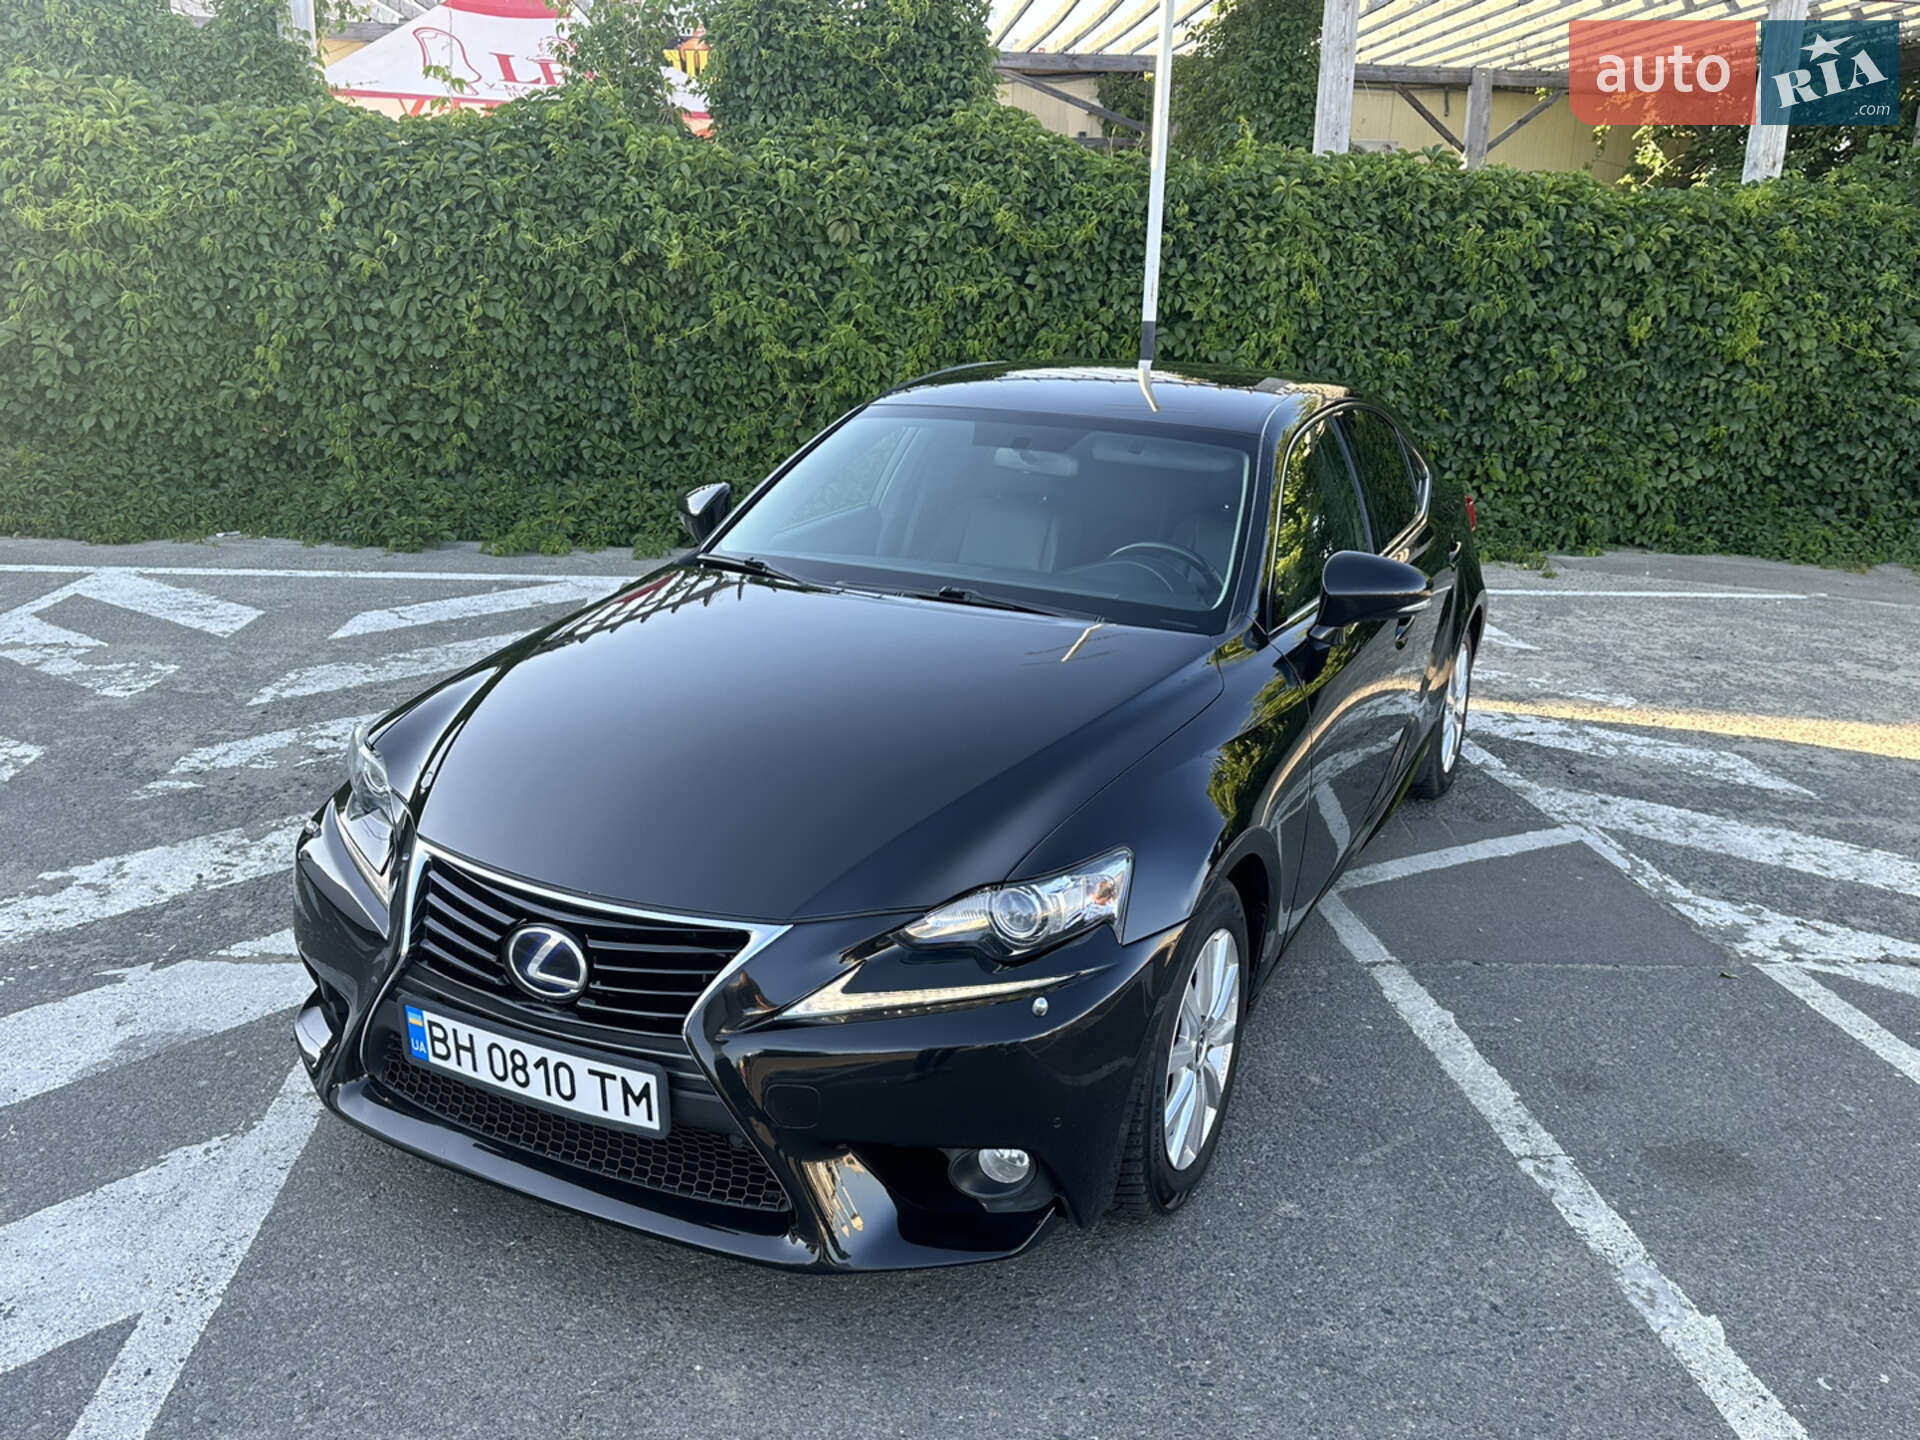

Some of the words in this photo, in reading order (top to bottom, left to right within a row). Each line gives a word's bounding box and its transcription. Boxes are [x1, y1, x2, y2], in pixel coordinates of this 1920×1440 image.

[410, 1038, 427, 1054] UA
[427, 1019, 478, 1073] BH
[487, 1043, 576, 1102] 0810
[588, 1068, 653, 1122] TM
